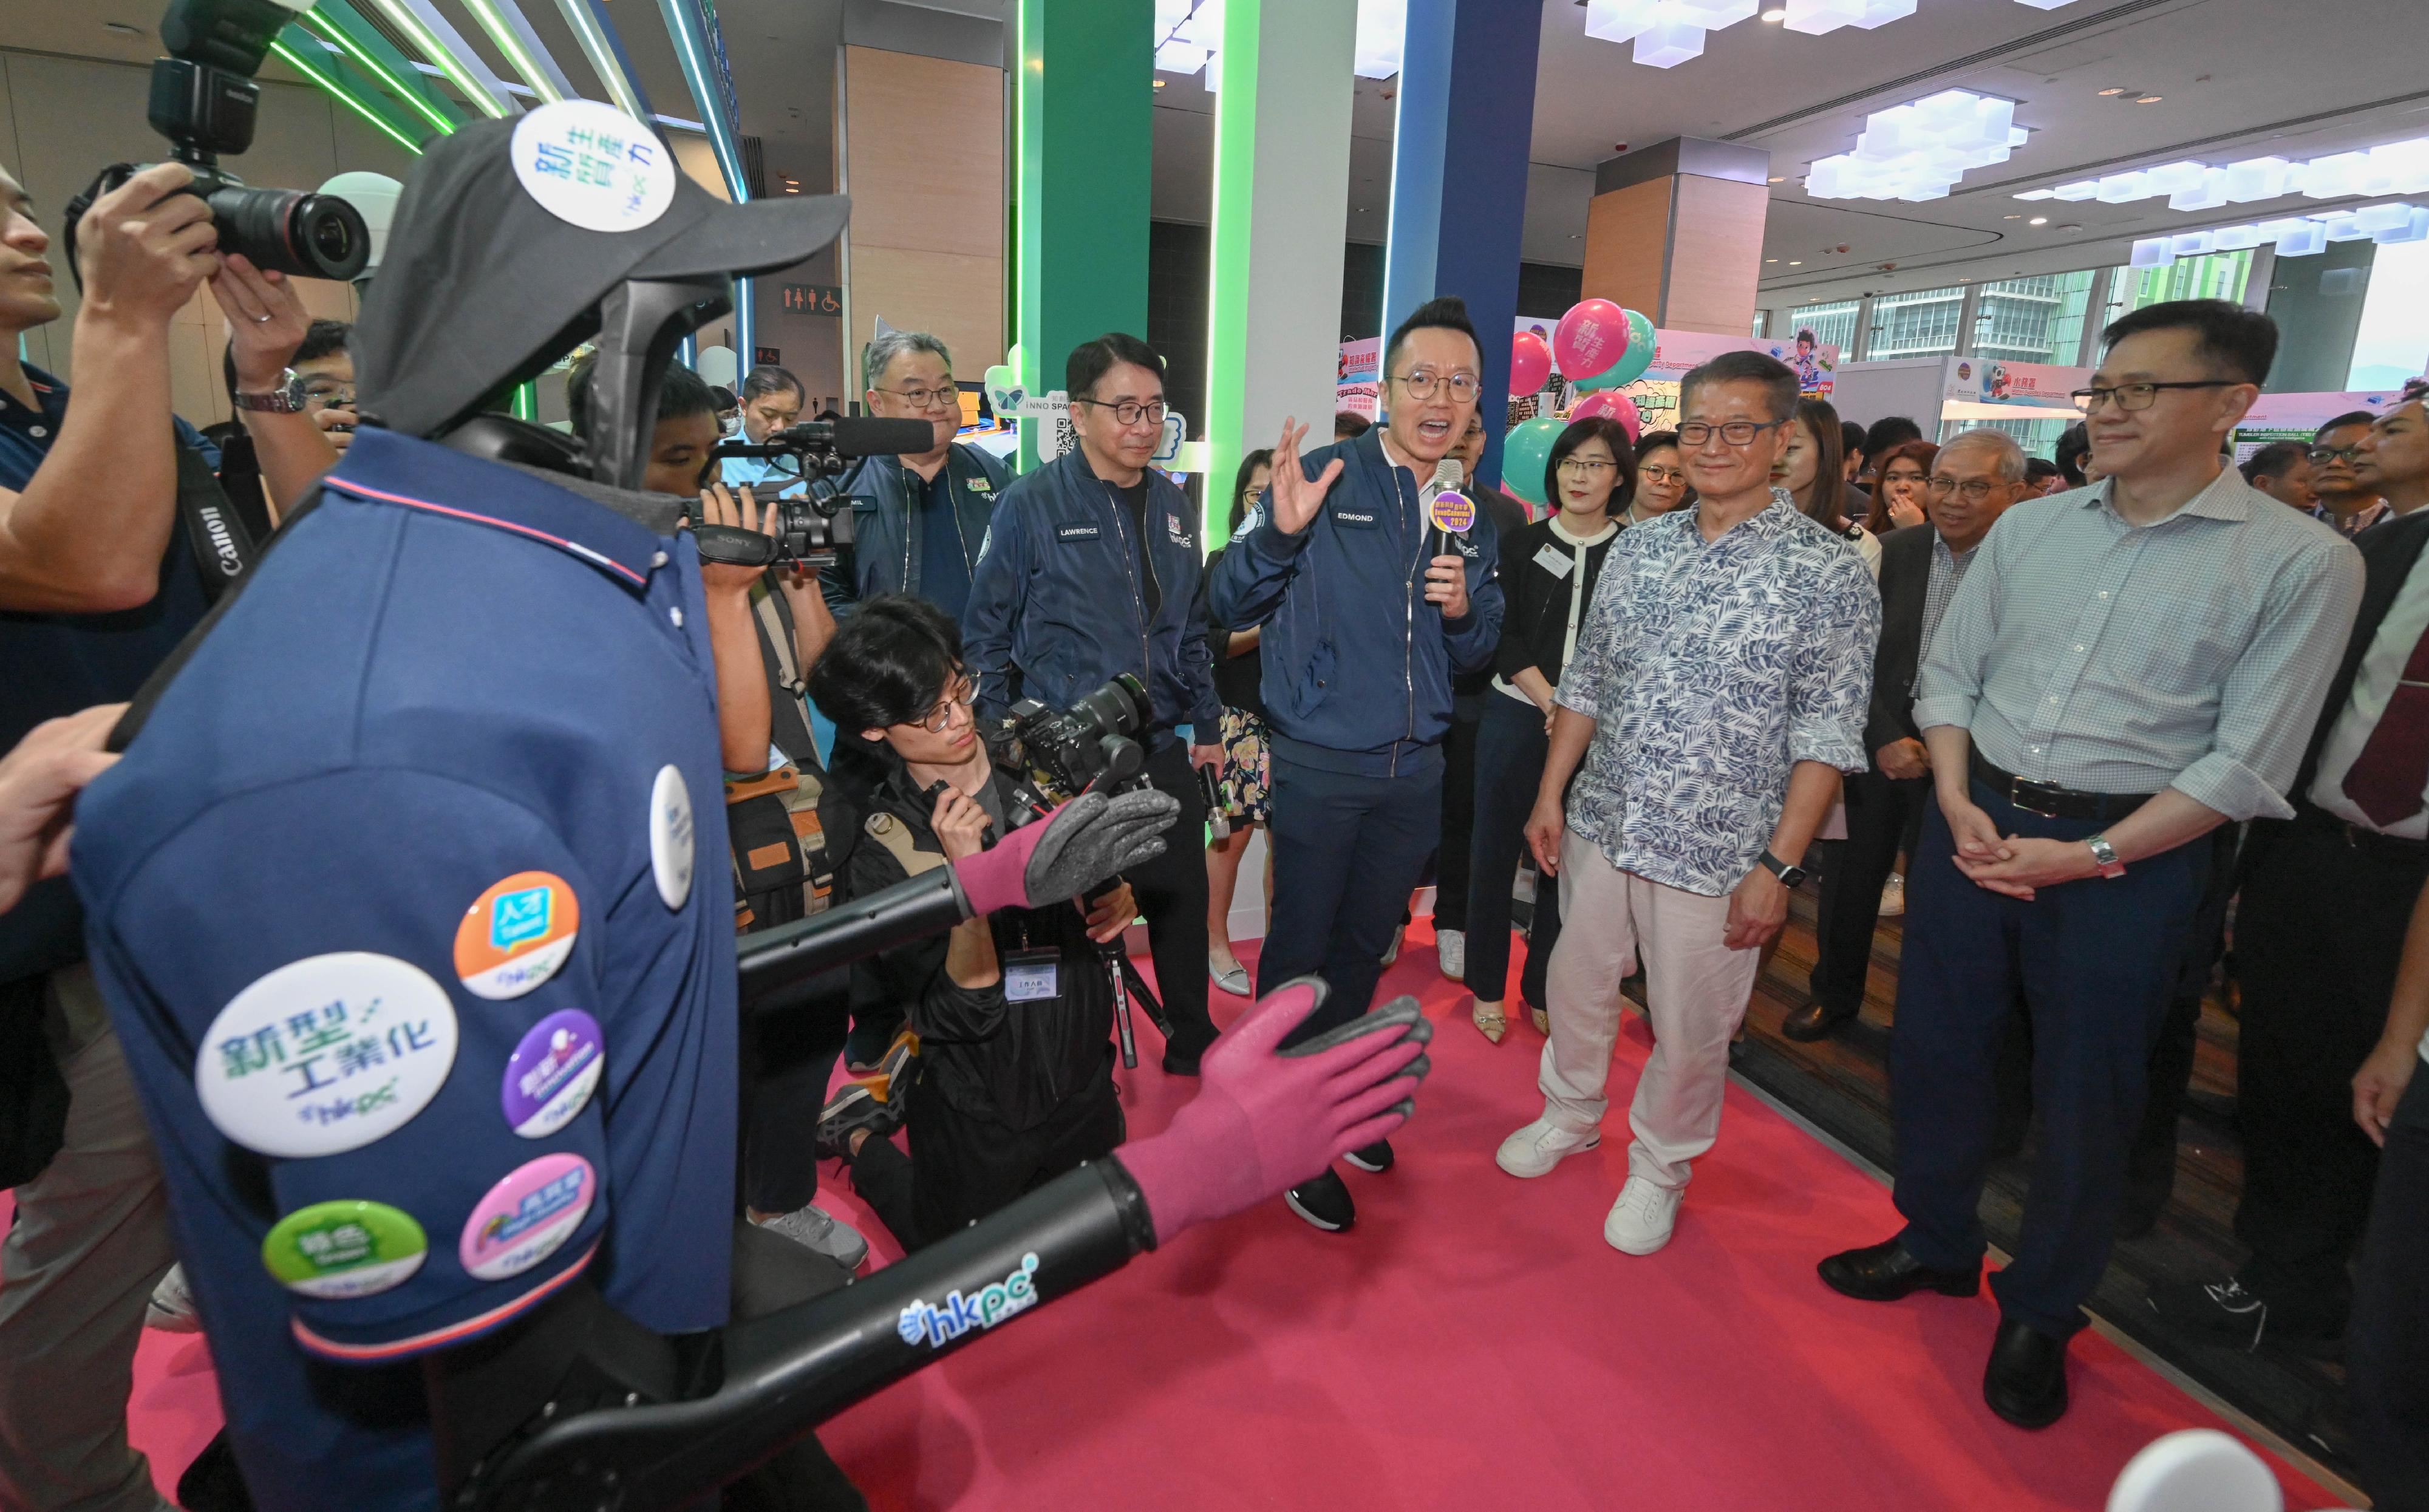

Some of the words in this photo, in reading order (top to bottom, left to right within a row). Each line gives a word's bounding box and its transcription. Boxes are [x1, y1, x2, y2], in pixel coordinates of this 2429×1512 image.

[1650, 361, 1664, 369] perty
[1337, 387, 1363, 398] Trade
[1363, 388, 1378, 398] Mar
[2014, 377, 2036, 387] 水務署
[1338, 513, 1373, 522] EDMOND
[200, 506, 242, 576] Canon
[717, 535, 752, 547] SONY
[498, 891, 542, 926] 人才
[220, 999, 352, 1078] 新型
[281, 1020, 436, 1099] 工業化
[924, 1275, 1031, 1342] hkpc
